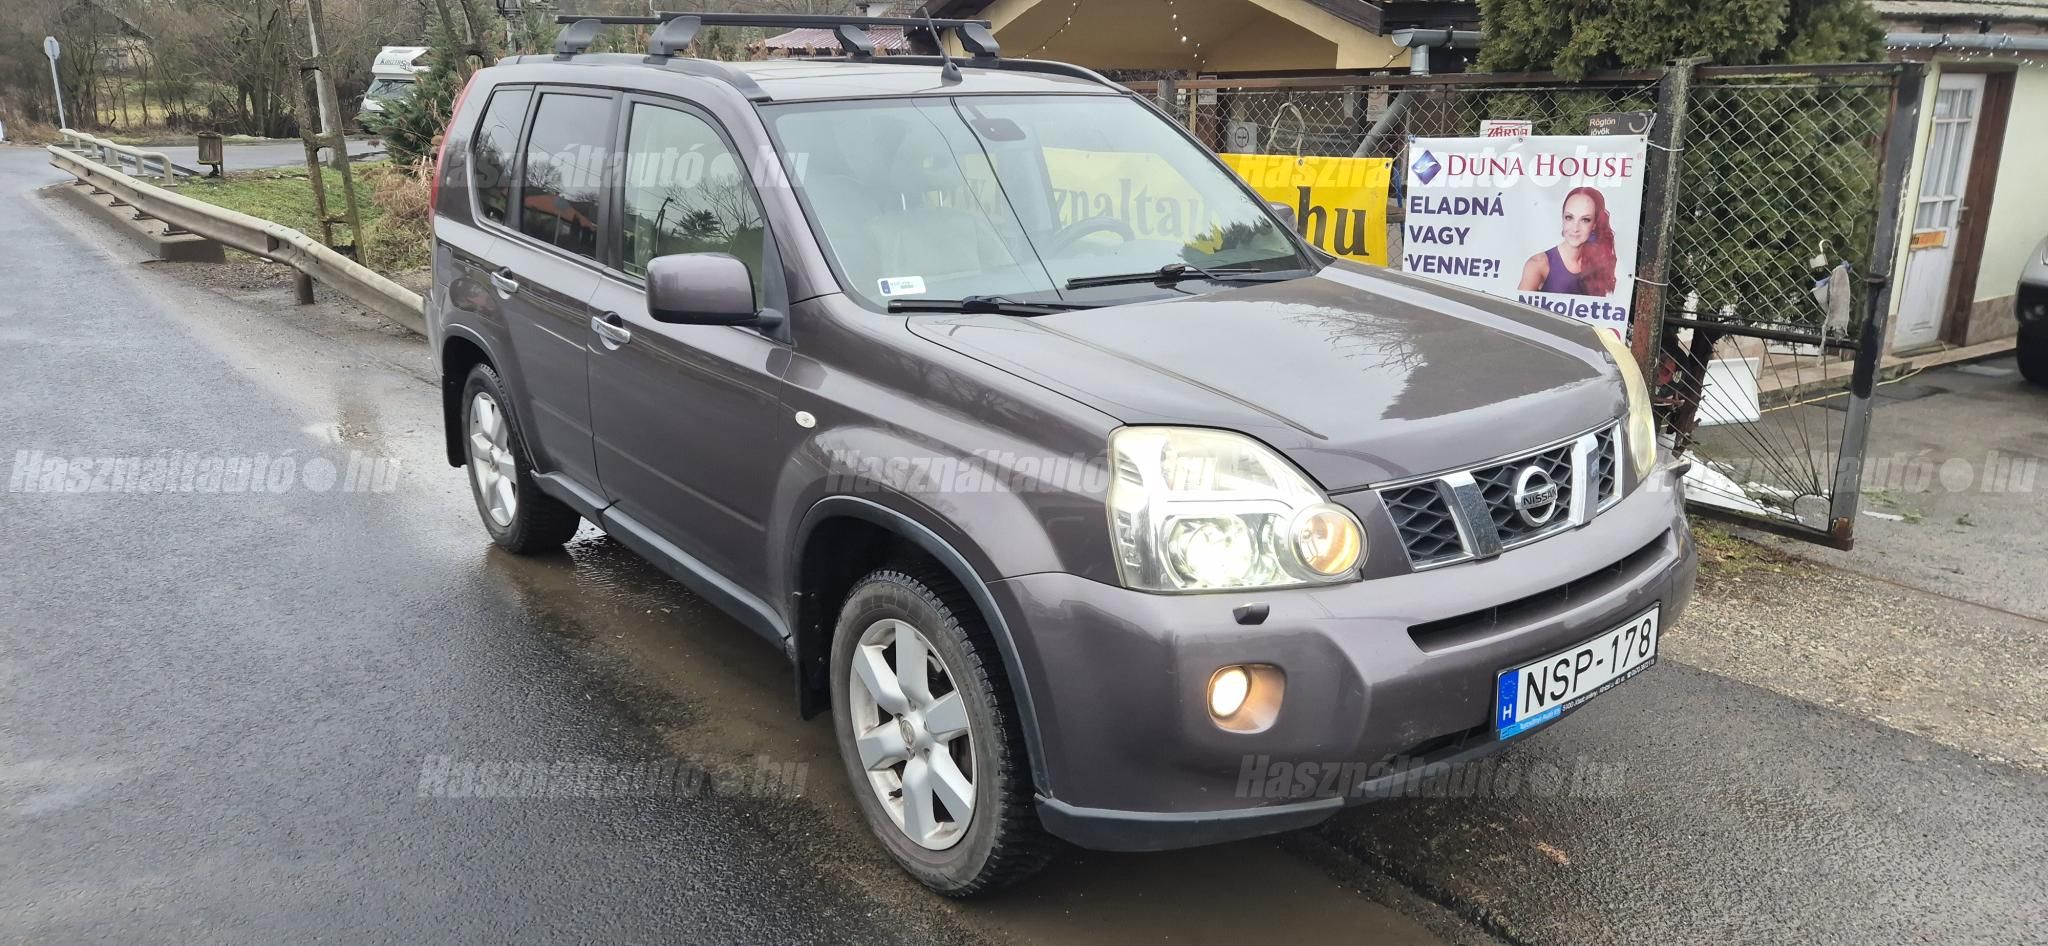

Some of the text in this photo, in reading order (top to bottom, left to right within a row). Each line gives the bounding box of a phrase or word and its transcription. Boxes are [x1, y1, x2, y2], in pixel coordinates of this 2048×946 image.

[1447, 154, 1634, 178] DUNA HOUSE
[1410, 192, 1504, 216] ELADNÁ
[1409, 225, 1470, 245] VAGY
[1408, 253, 1501, 278] VENNE?!
[1523, 487, 1557, 505] NISSAN
[1524, 617, 1652, 714] NSP-178
[1502, 703, 1513, 721] H
